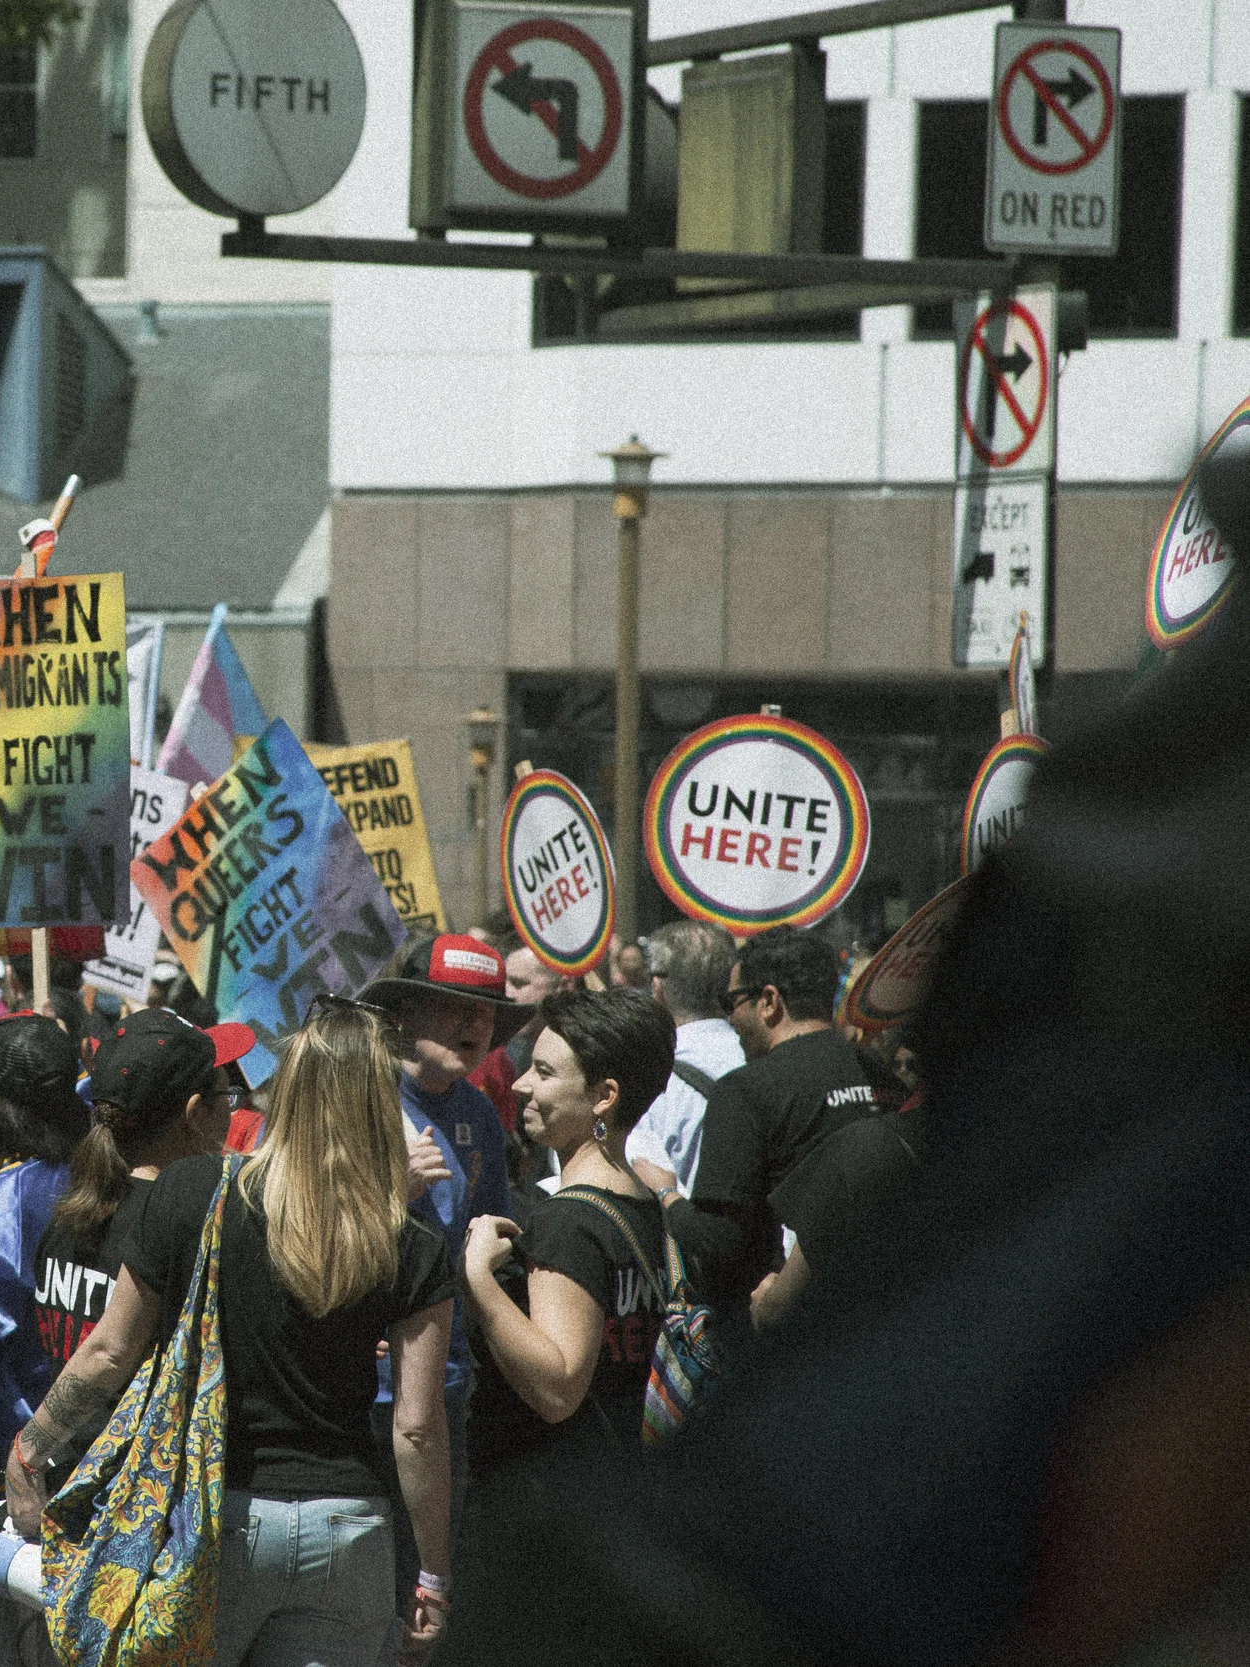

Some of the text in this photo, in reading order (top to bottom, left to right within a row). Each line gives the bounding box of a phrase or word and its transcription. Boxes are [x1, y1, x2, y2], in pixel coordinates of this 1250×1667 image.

[210, 72, 331, 113] FIFTH
[1000, 190, 1106, 230] ON RED
[3, 732, 96, 787] FIGHT
[321, 756, 400, 796] EFEND
[142, 740, 284, 893] WHEN
[340, 794, 415, 833] XPAND
[687, 780, 832, 834] UNITE
[169, 793, 305, 944] QUEERS
[518, 819, 587, 894] UNITE
[679, 823, 823, 877] HERE!
[220, 865, 304, 973] FIGHT
[530, 857, 600, 933] HERE!
[827, 1085, 873, 1107] UNITE
